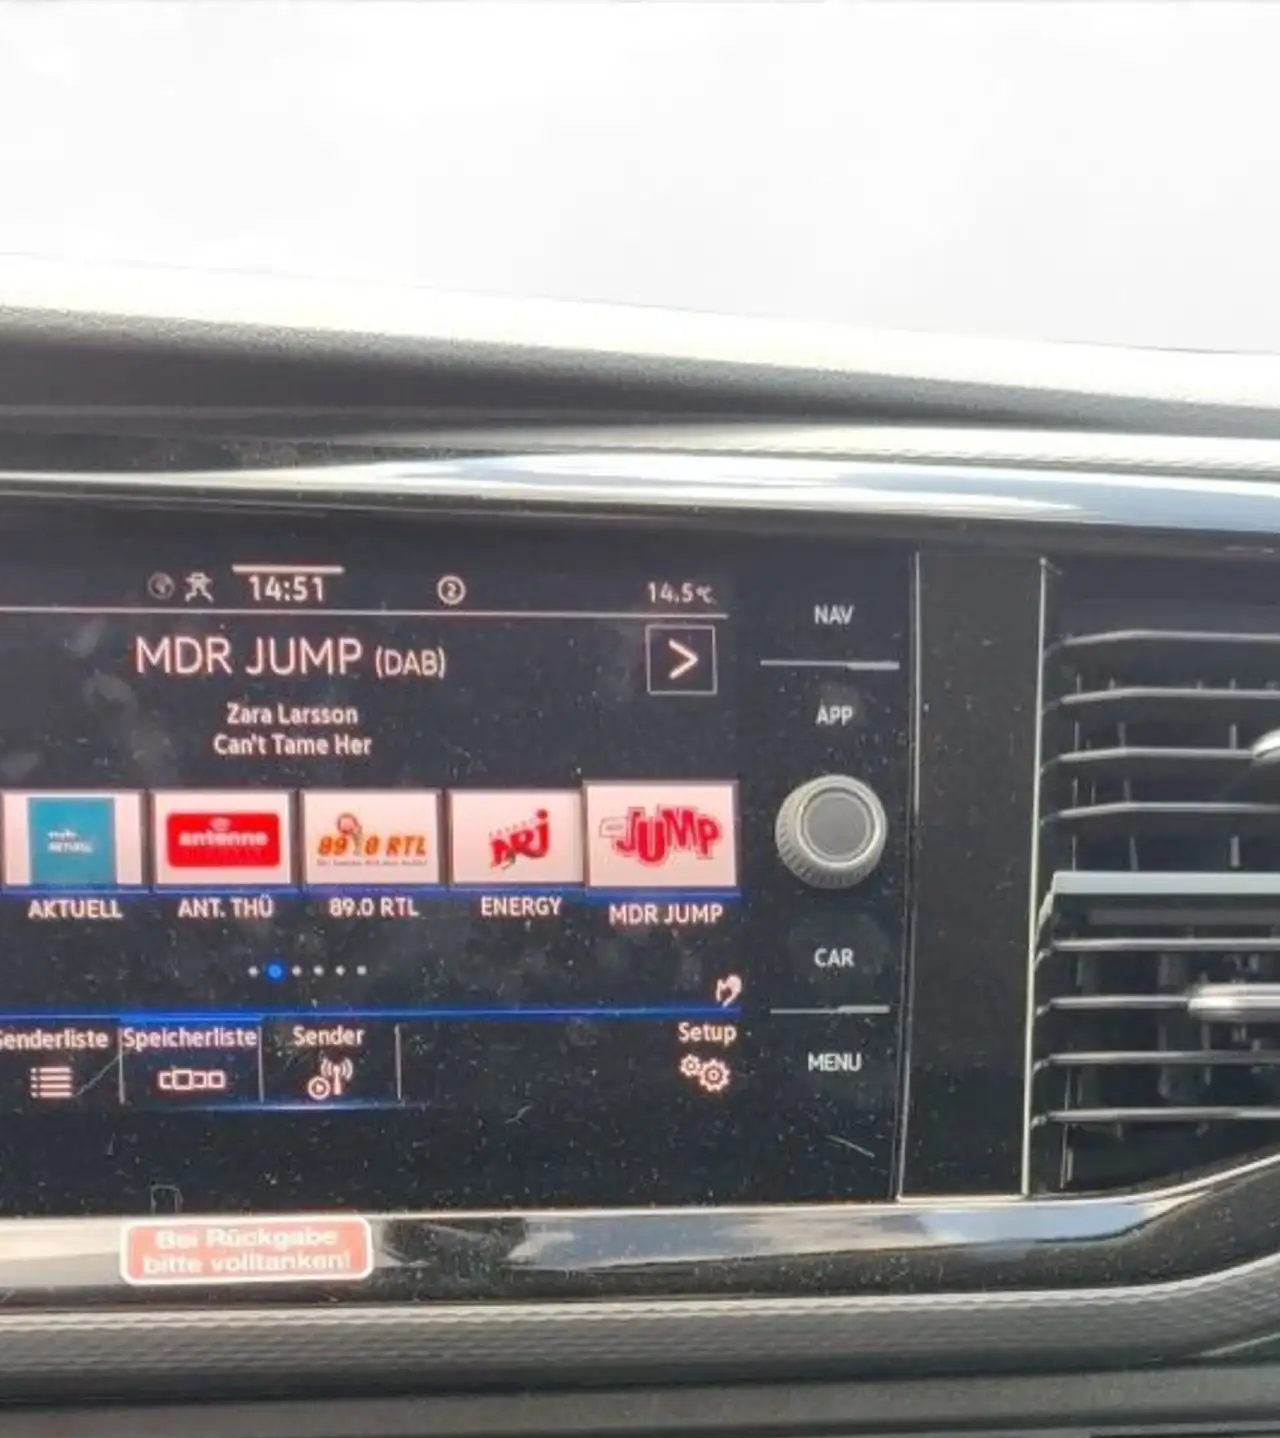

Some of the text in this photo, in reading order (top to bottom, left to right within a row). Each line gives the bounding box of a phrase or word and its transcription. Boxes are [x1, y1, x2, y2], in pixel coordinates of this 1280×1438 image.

[248, 575, 323, 601] 14:51
[814, 605, 854, 625] NAV
[135, 635, 446, 679] MDR JUMP (DAB)
[226, 702, 358, 725] Zara Larsson
[816, 706, 853, 725] APP
[213, 733, 372, 756] Can't Tame Her
[178, 829, 269, 847] antenne
[614, 804, 721, 866] JUMP
[28, 899, 124, 919] AKTUELL
[178, 893, 274, 918] ANT. THÜ
[329, 897, 420, 917] 89.0 RTL
[480, 897, 562, 917] ENERGY
[609, 904, 723, 924] MDR JUMP
[814, 948, 854, 968] CAR
[123, 1027, 257, 1051] Speicherliste
[293, 1025, 365, 1045] Sender
[678, 1023, 737, 1046] Setup
[808, 1053, 862, 1072] MENU
[207, 1227, 338, 1249] Rückgabe
[143, 1250, 350, 1275] bitte volltanken!
